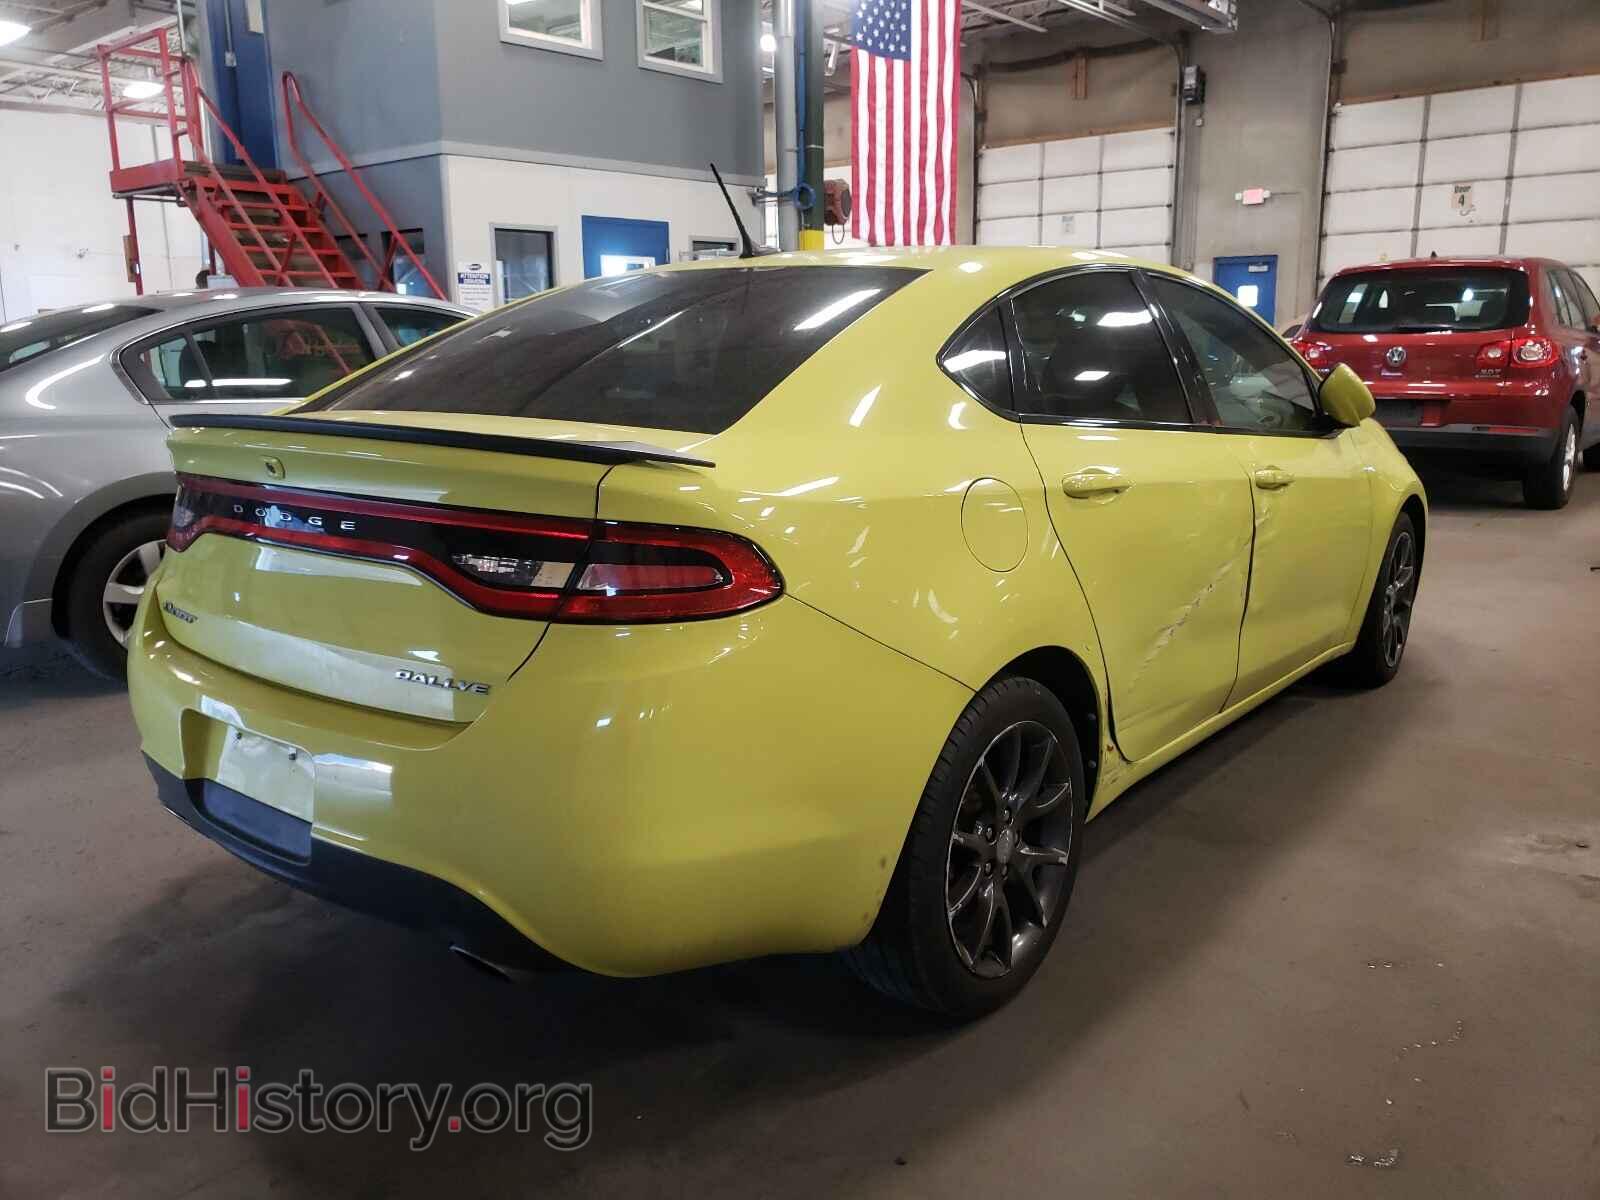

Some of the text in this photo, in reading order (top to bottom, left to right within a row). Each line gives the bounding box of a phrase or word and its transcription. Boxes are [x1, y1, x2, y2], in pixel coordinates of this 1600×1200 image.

[1458, 194, 1465, 207] 4
[233, 504, 356, 530] DODGE
[394, 668, 492, 696] RALLYE
